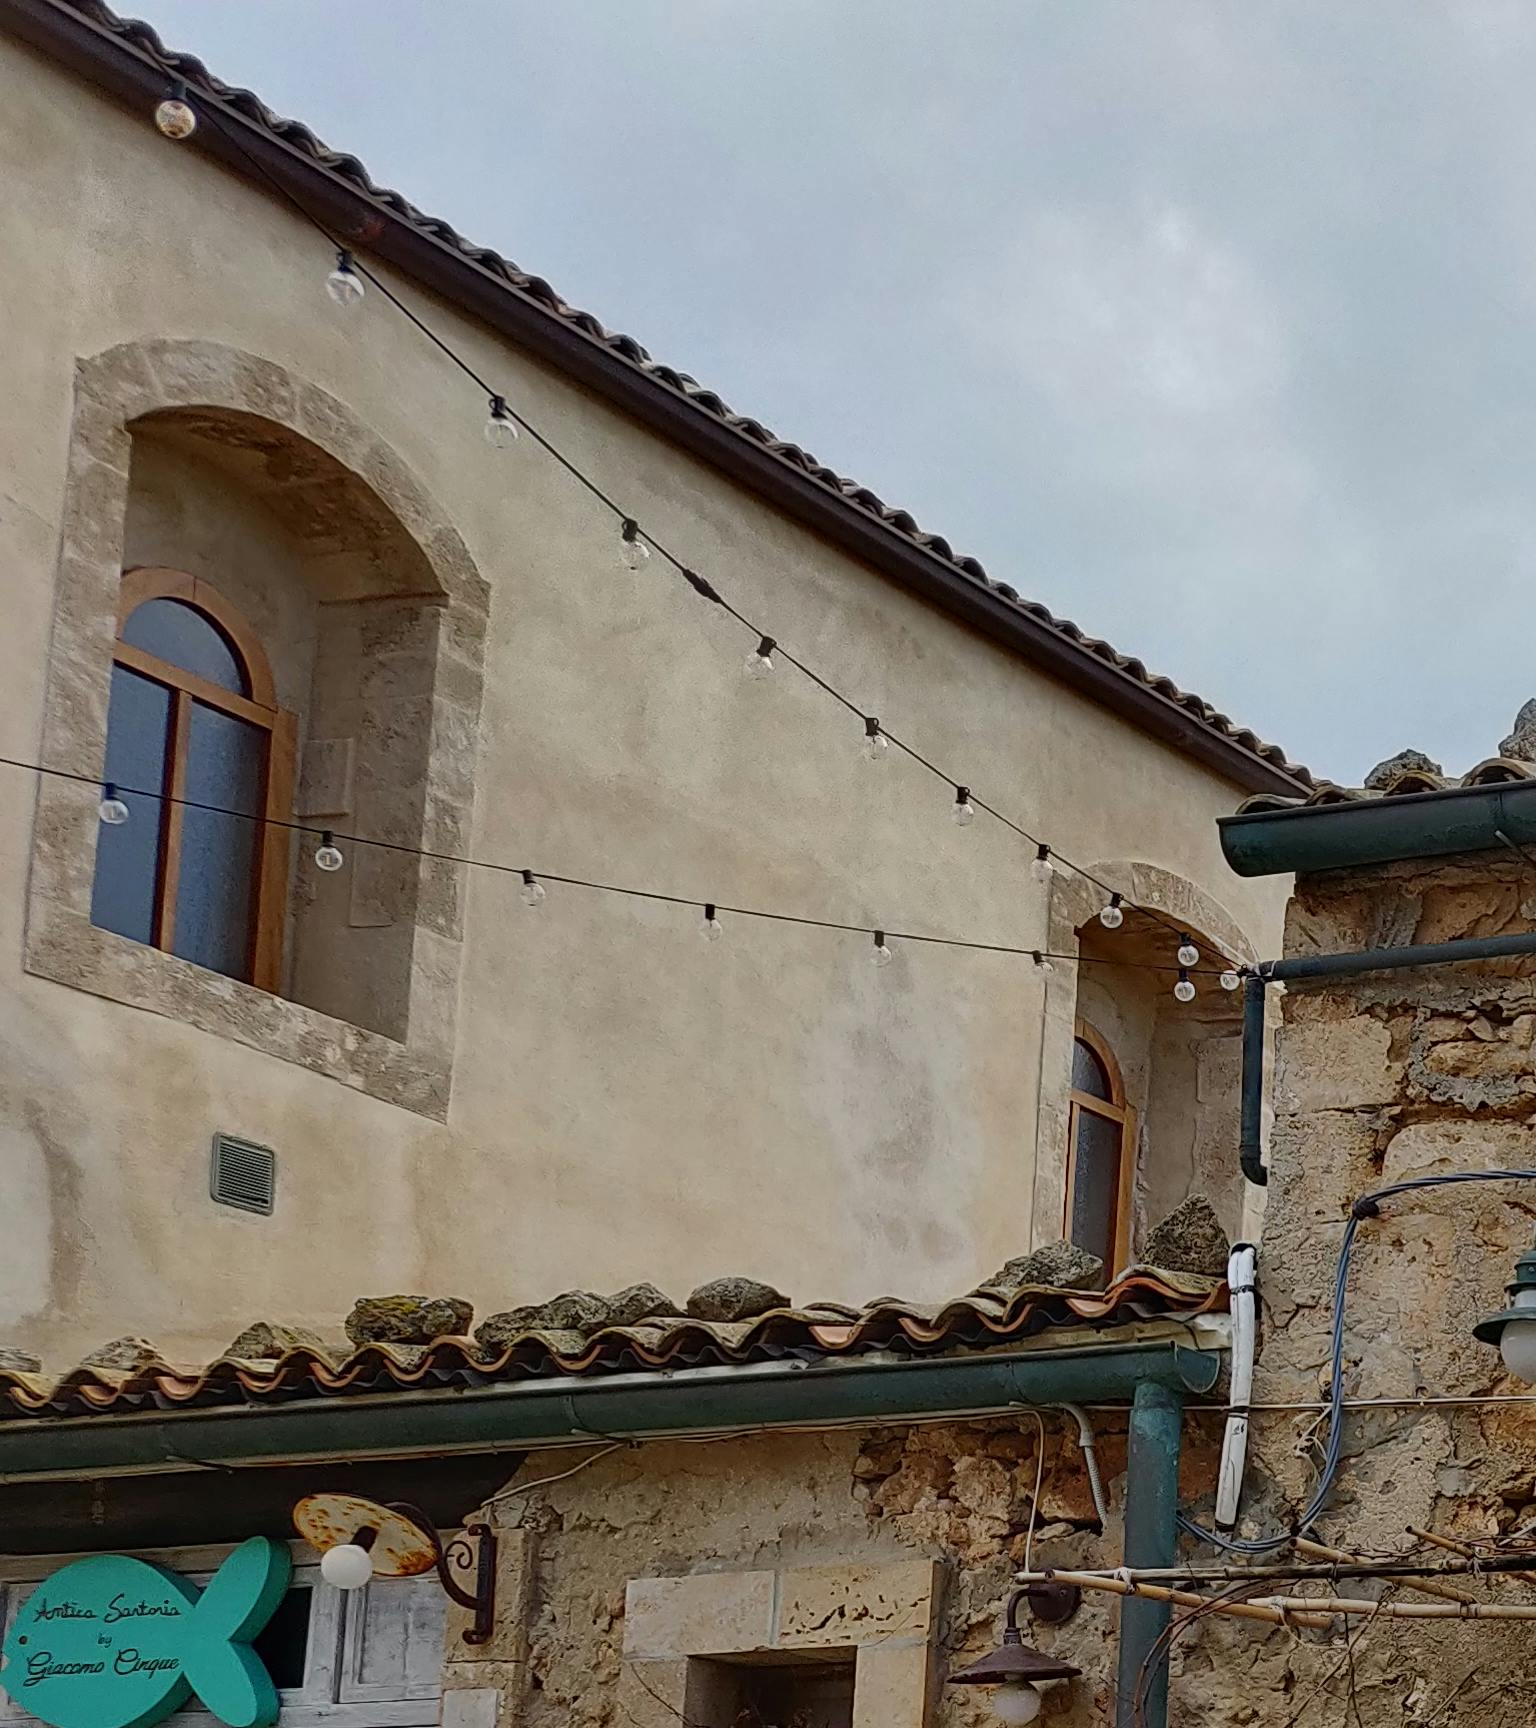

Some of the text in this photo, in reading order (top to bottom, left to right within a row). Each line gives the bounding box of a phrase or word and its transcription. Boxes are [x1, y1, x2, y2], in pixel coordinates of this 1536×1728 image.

[33, 1592, 182, 1623] Antica Sartoria
[97, 1633, 113, 1648] by
[23, 1648, 180, 1687] Giacomo Cinque
